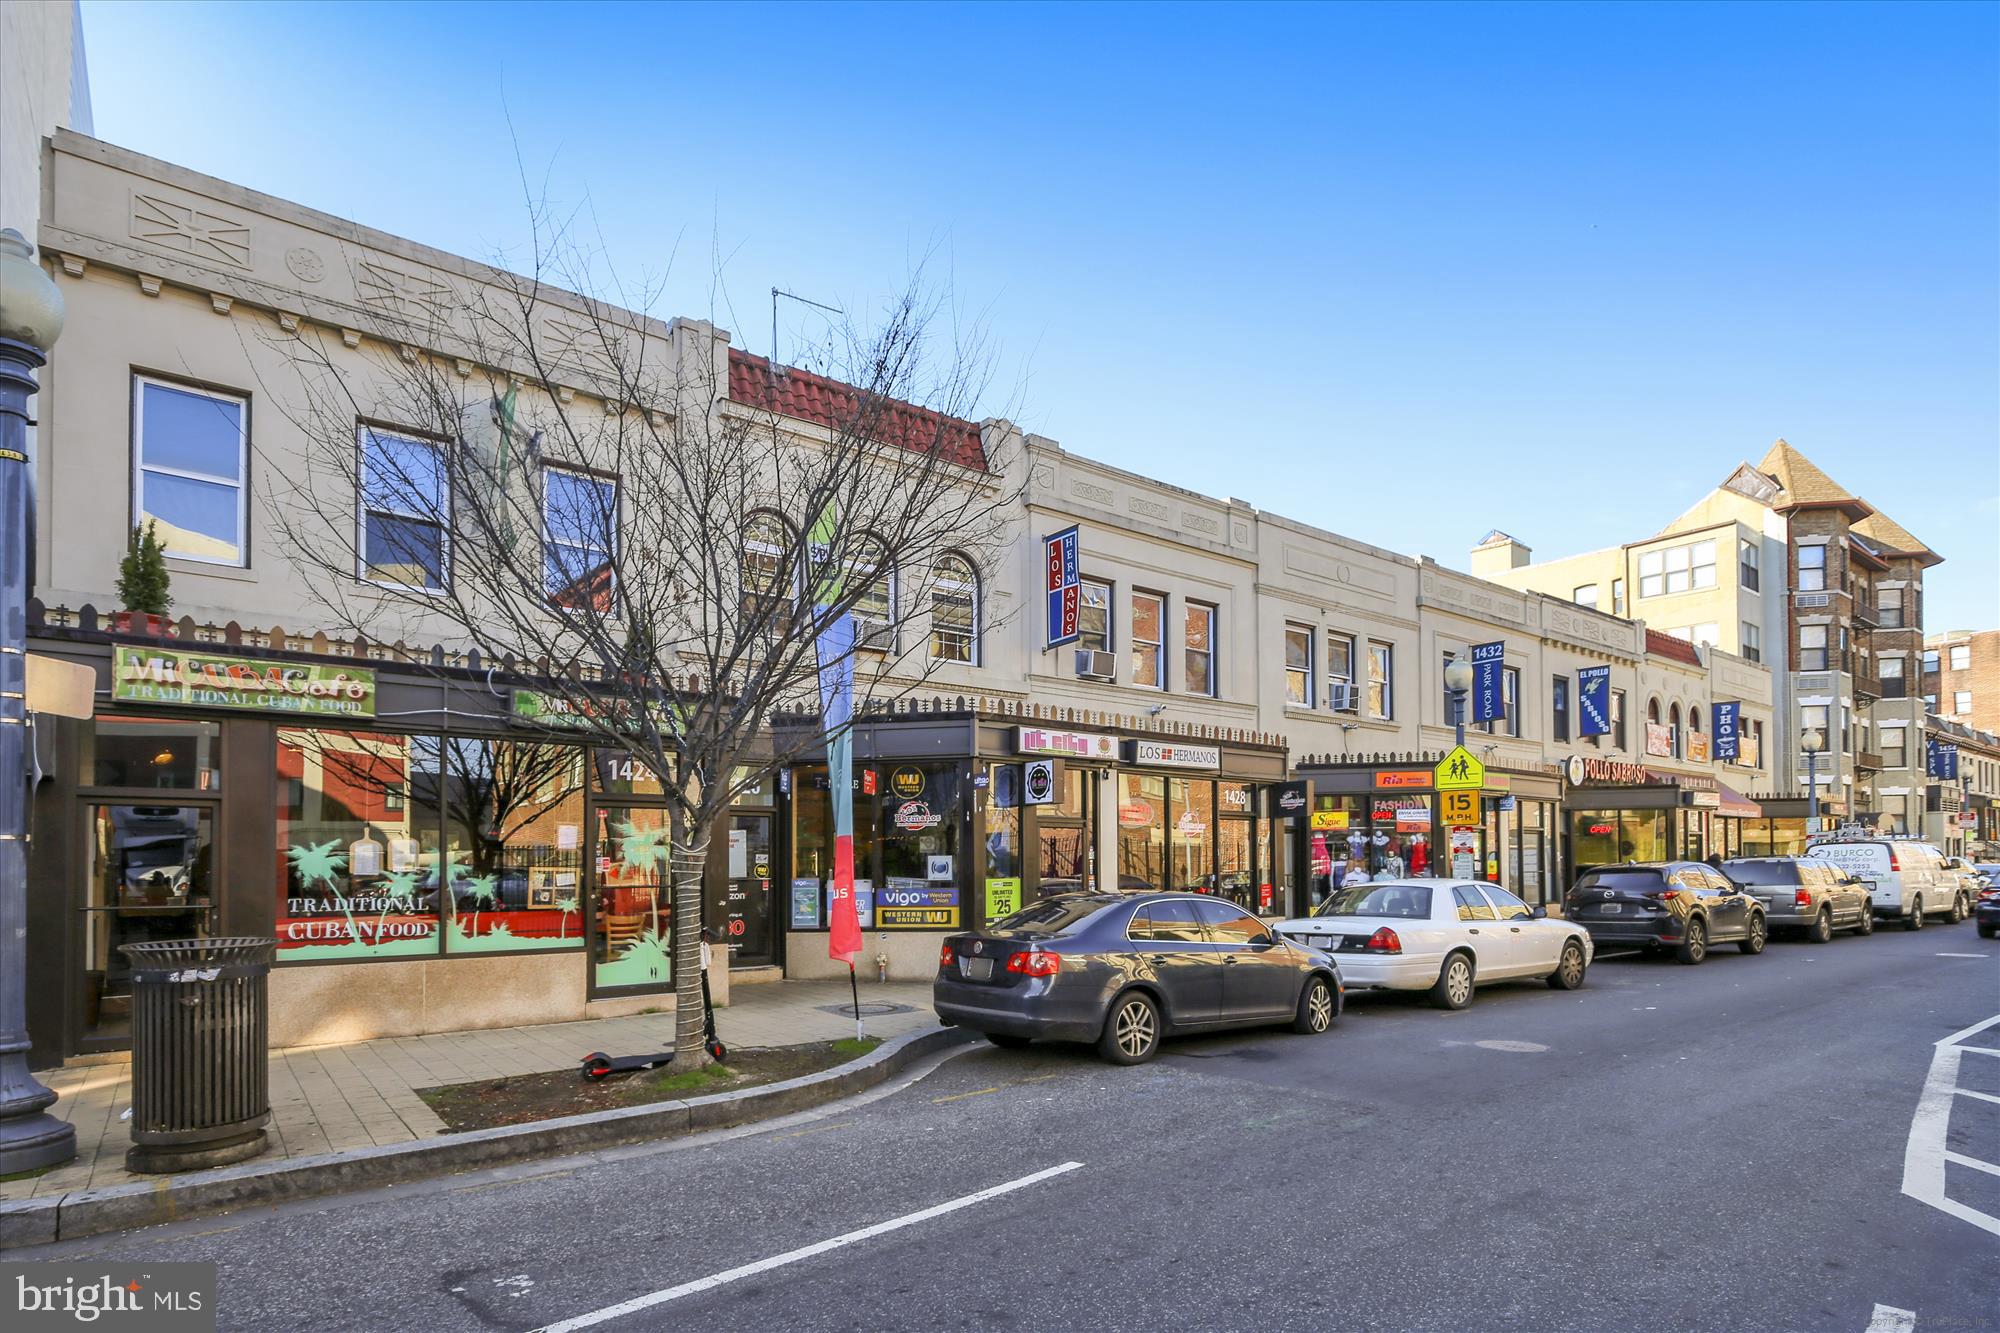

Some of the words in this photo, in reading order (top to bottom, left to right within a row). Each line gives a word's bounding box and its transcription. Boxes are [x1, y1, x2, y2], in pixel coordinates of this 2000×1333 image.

[1050, 545, 1061, 587] LOS
[1473, 644, 1502, 659] 1432
[1483, 663, 1492, 688] PARK
[1580, 671, 1587, 679] EL
[1588, 668, 1609, 678] POLLO
[127, 684, 251, 704] TRADITIONAL
[257, 693, 315, 711] CUBAN
[320, 700, 362, 714] FOOD
[1484, 689, 1493, 719] ROAD
[1580, 695, 1609, 733] SABROSO
[1720, 705, 1732, 735] PHO
[1140, 745, 1160, 760] LOS
[1173, 749, 1217, 764] HERMANOS
[1720, 749, 1734, 757] 14
[896, 774, 919, 785] WU
[1382, 774, 1403, 785] Ria
[1611, 762, 1646, 784] SABROSO
[1225, 789, 1246, 805] 1428
[1374, 800, 1423, 810] FASHION
[1448, 794, 1471, 811] 15
[895, 814, 941, 823] Hermanos
[1317, 814, 1341, 828] Sigue
[1371, 811, 1393, 820] OPEN
[1590, 825, 1612, 834] OPEN
[1833, 849, 1874, 857] BURCO
[287, 897, 430, 913] TRADITIONAL
[885, 890, 921, 906] vigo
[993, 899, 1012, 915] $25
[924, 911, 948, 923] WU
[287, 921, 373, 940] CUBAN
[379, 922, 429, 937] FOOD
